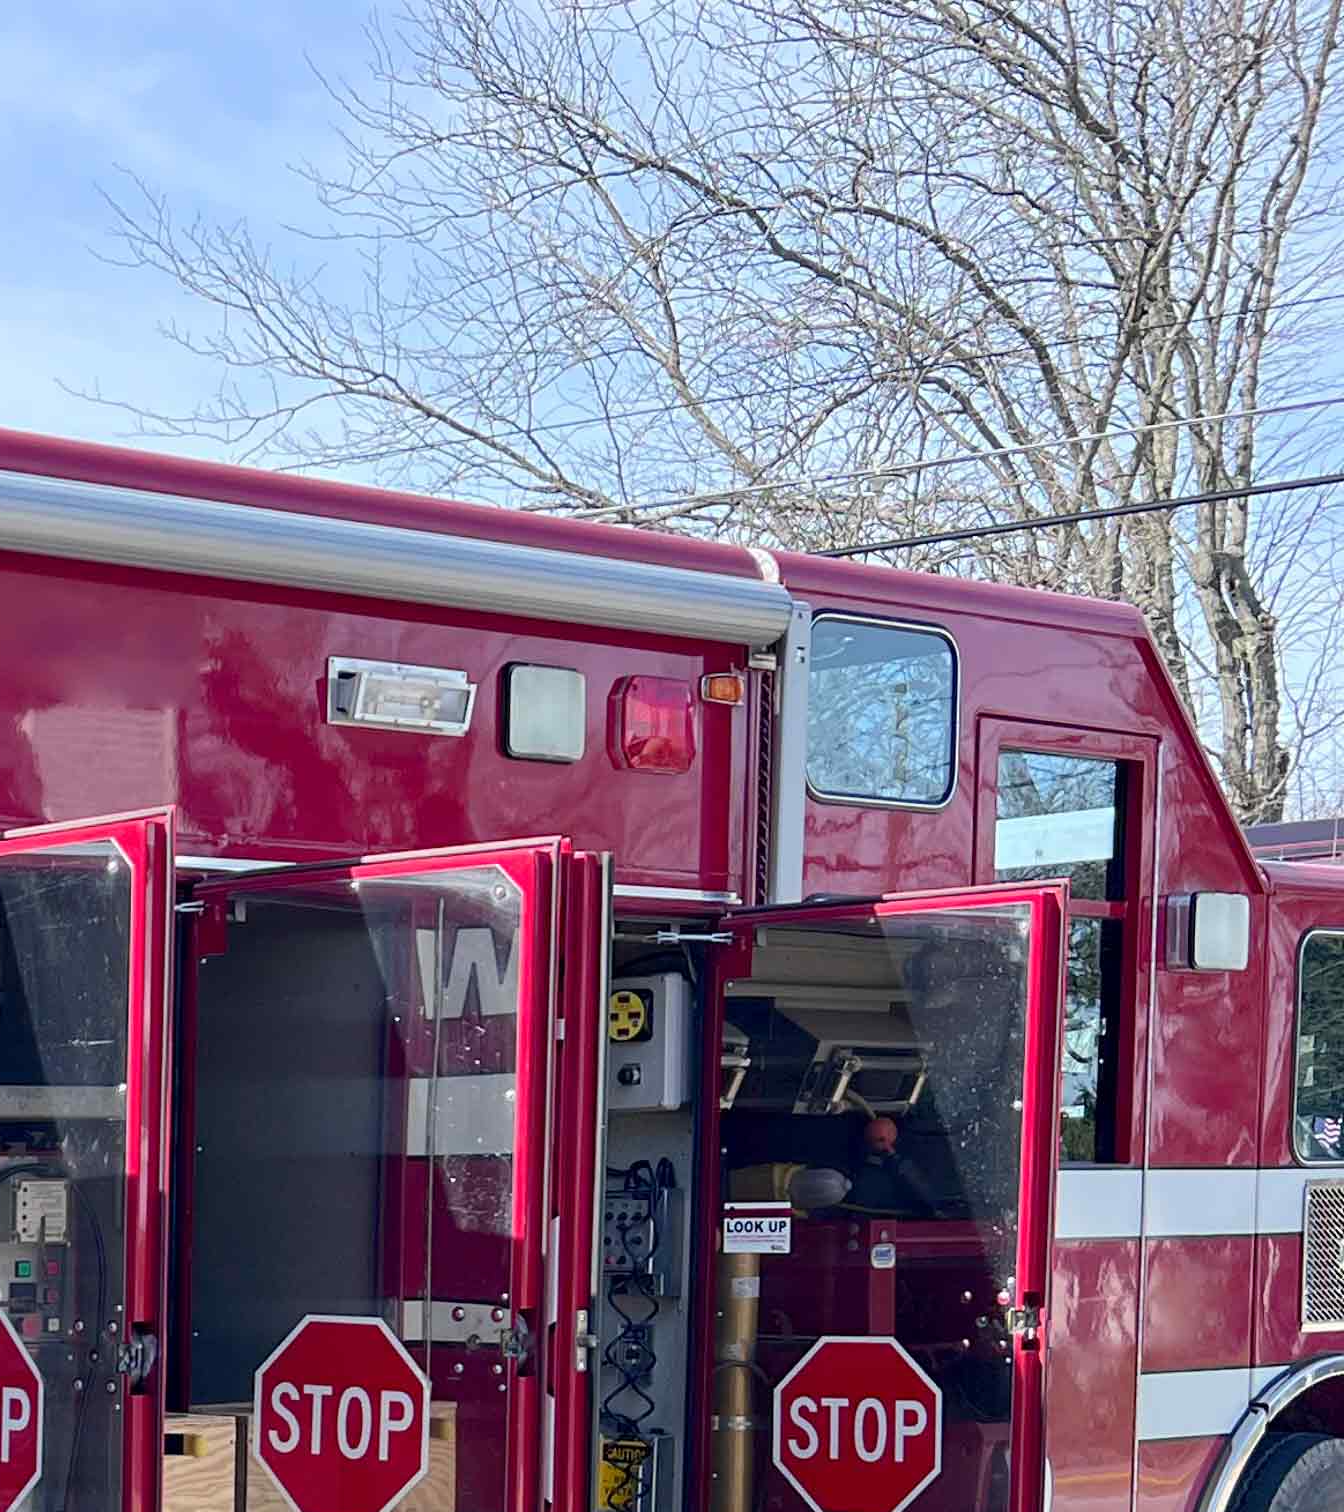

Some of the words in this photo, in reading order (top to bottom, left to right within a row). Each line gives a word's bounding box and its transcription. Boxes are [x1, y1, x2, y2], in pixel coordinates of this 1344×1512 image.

[726, 1220, 764, 1233] LOOK
[768, 1220, 787, 1233] UP
[267, 1381, 415, 1462] STOP
[787, 1396, 928, 1464] STOP
